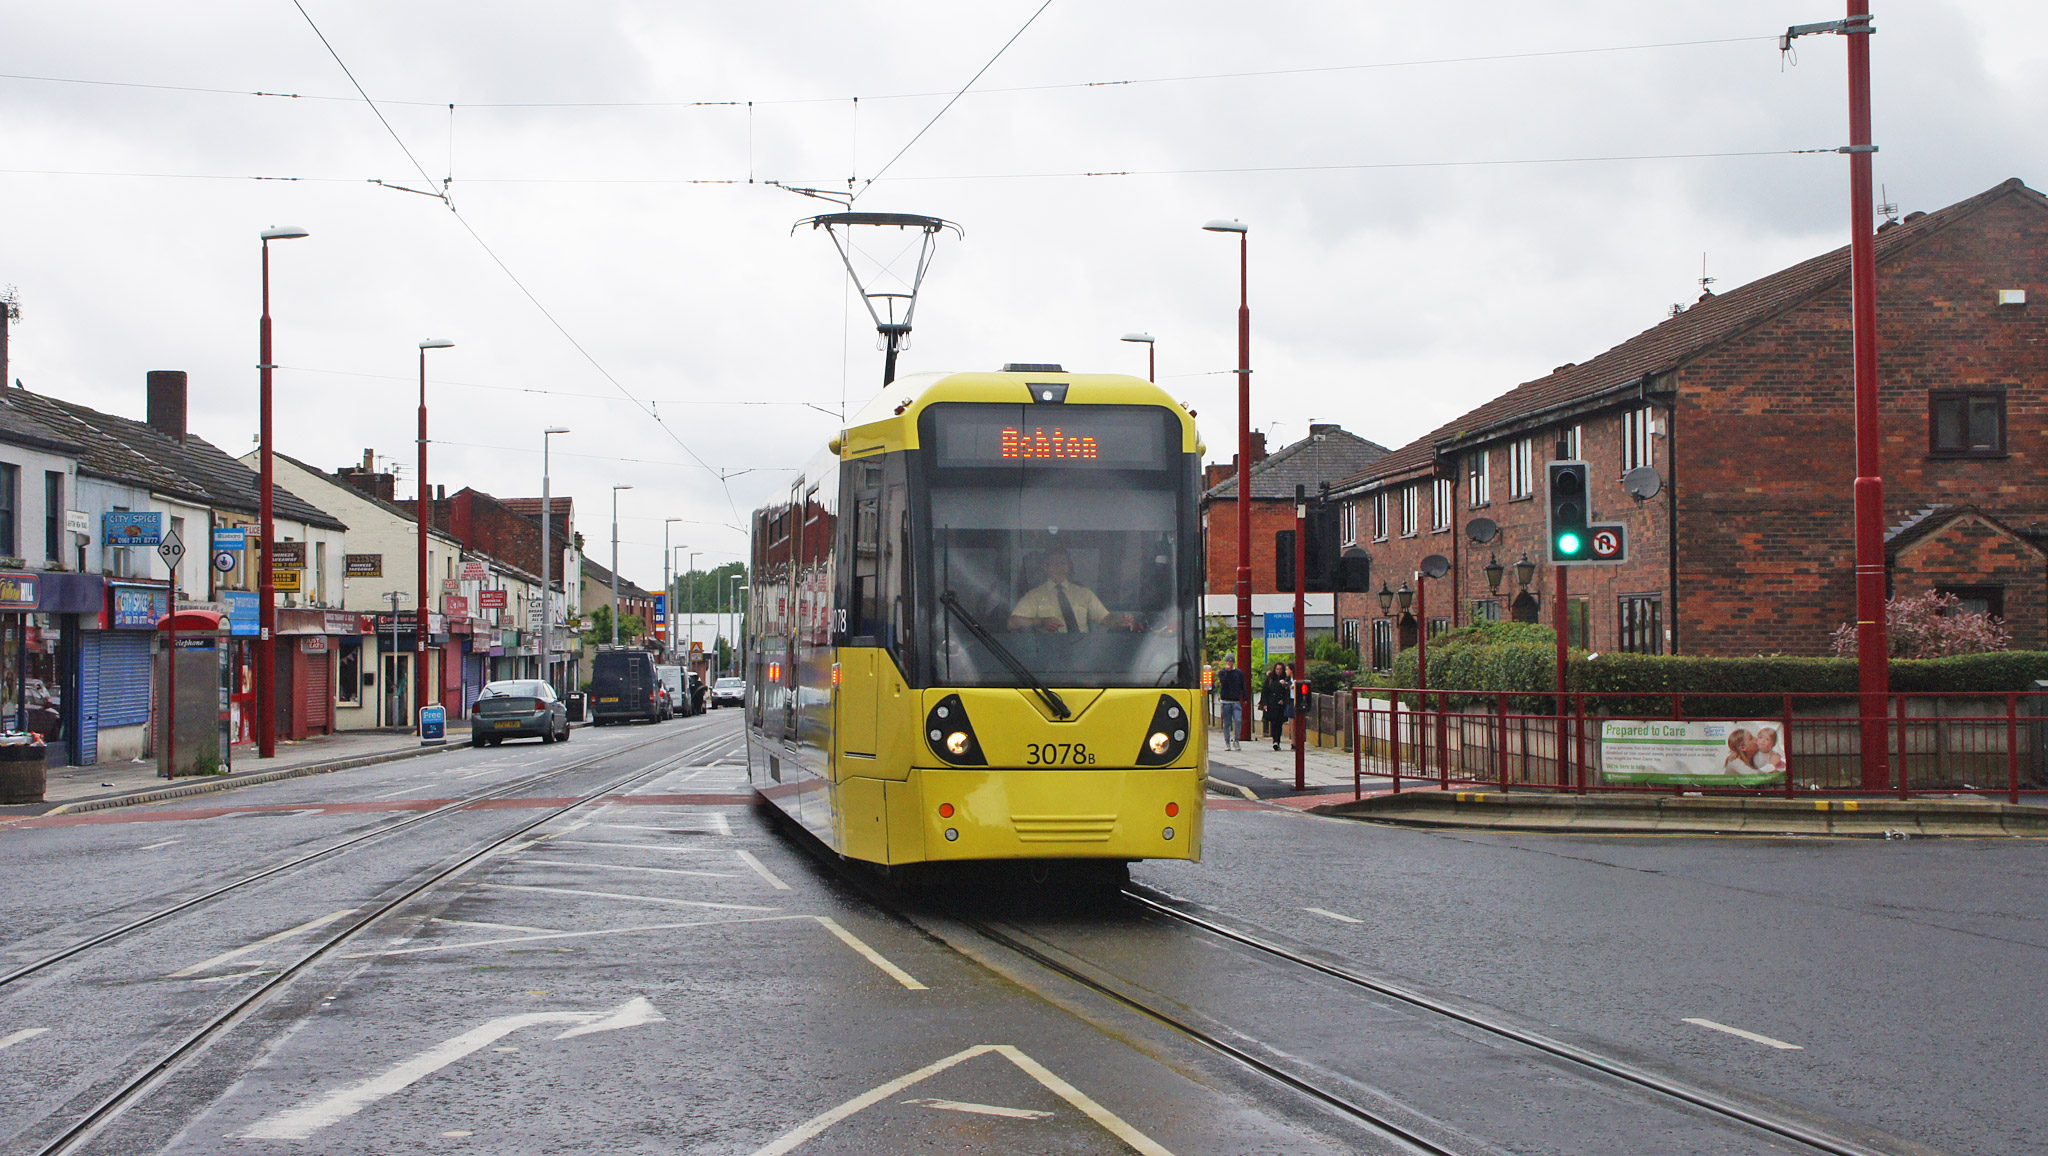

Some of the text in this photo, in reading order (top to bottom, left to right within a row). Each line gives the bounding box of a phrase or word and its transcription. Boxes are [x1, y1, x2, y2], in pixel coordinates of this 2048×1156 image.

[1002, 428, 1097, 458] Ashton
[109, 515, 158, 523] CITY SPICE
[162, 545, 181, 556] 30
[20, 583, 33, 601] HILL
[1606, 724, 1686, 738] Prepared to Care
